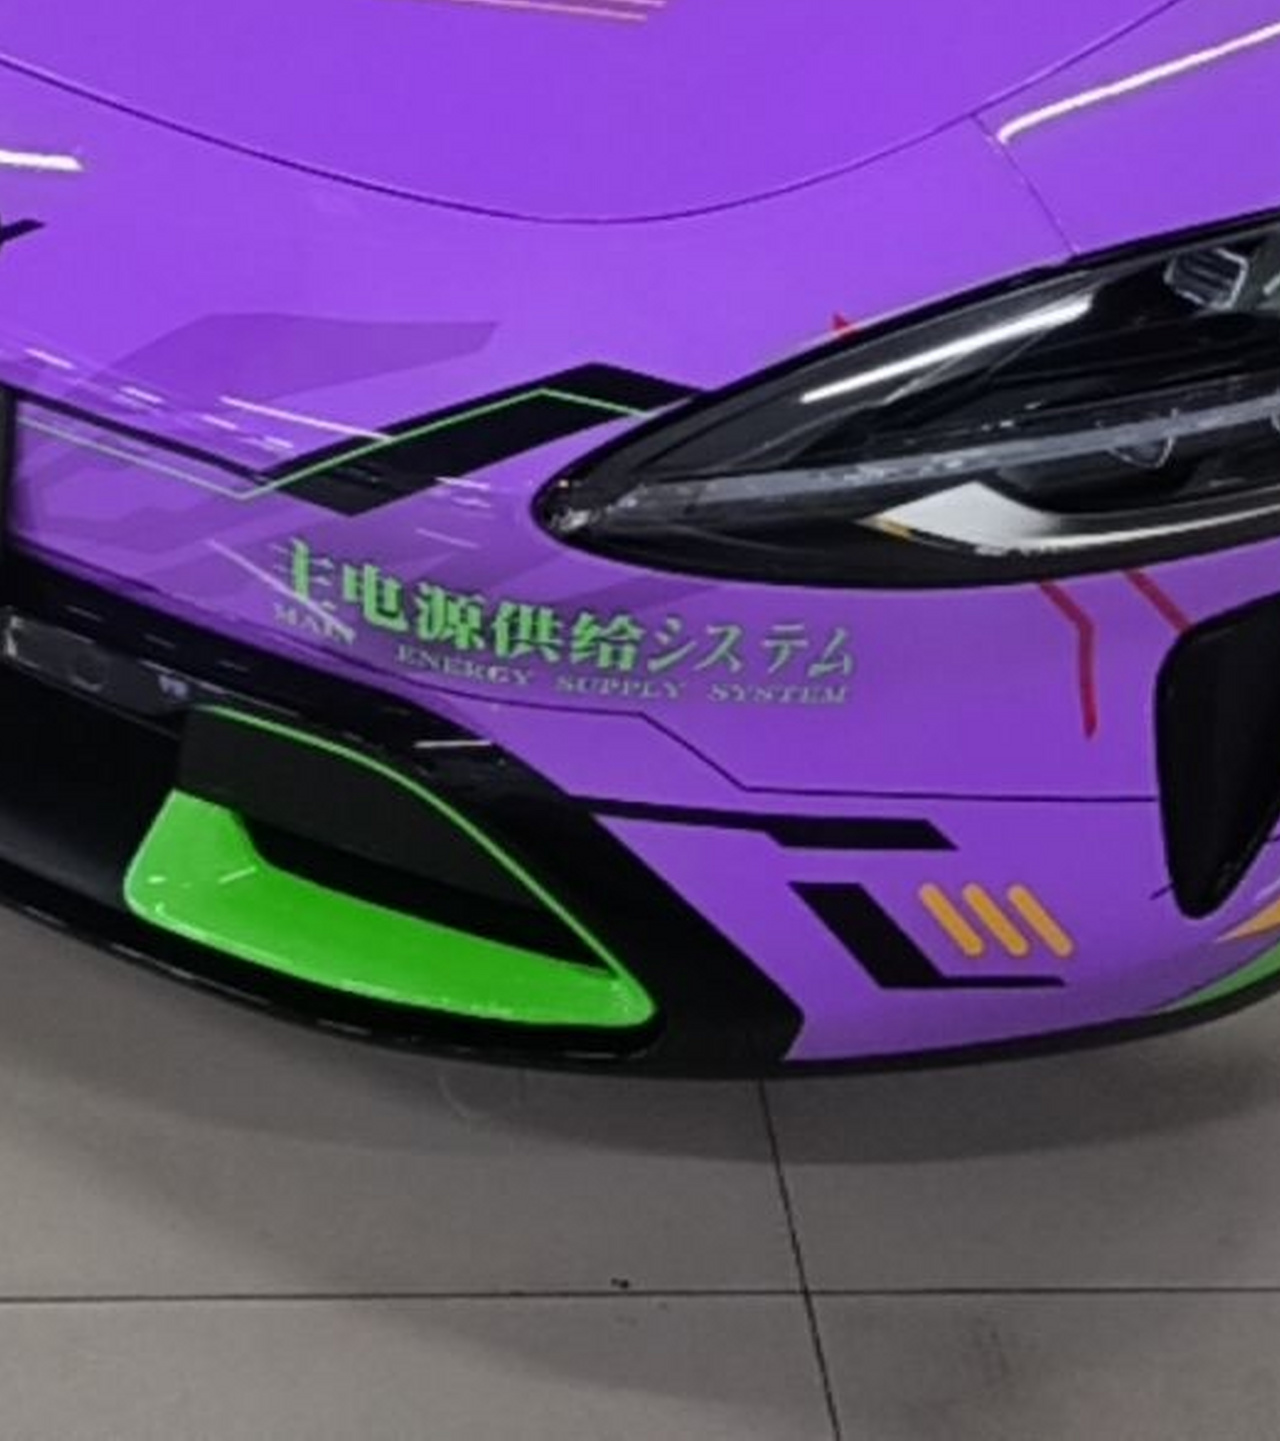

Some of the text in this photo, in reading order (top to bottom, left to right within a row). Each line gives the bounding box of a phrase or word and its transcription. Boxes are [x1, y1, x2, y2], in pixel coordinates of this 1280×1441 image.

[398, 644, 531, 686] ENERGY
[556, 674, 686, 699] SUPPLY
[707, 682, 849, 704] SYSTEM
